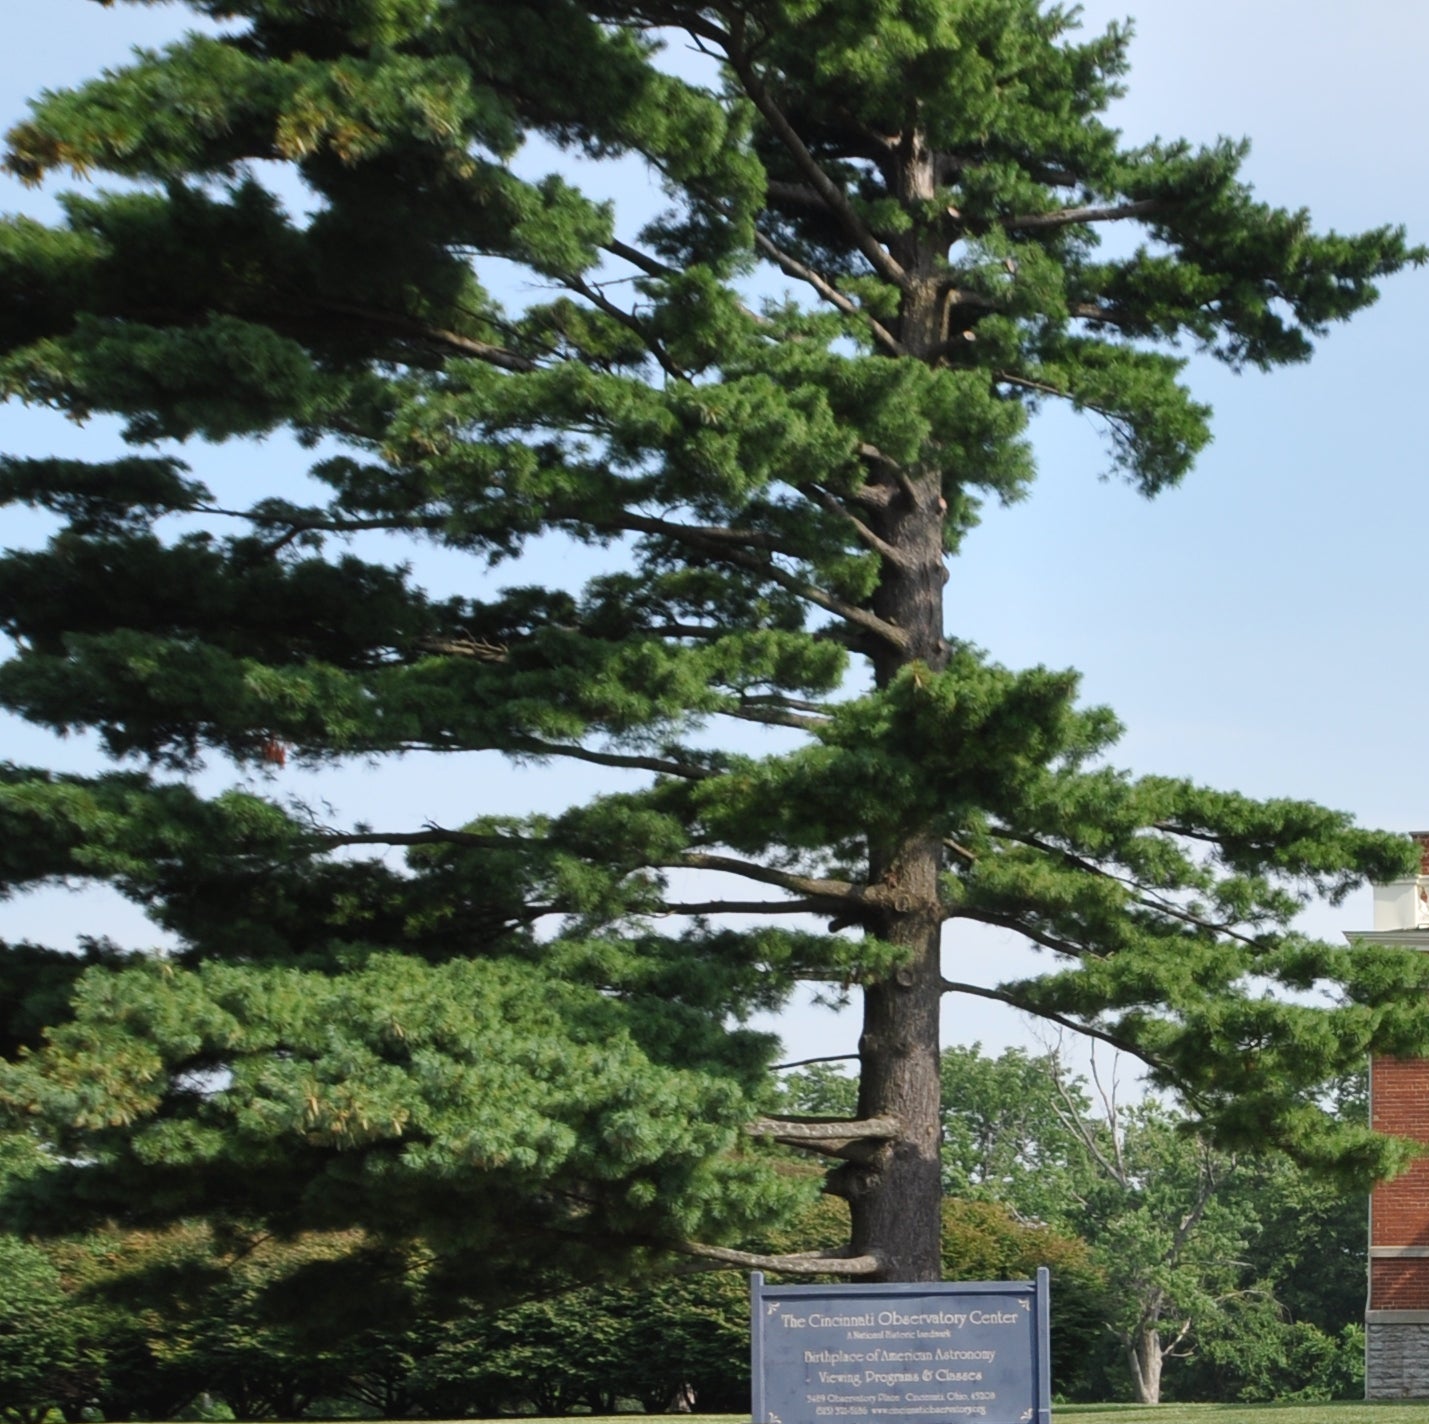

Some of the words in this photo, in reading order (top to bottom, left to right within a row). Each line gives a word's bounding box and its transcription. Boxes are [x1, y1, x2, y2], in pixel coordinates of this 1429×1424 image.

[781, 1314, 806, 1328] The
[808, 1313, 875, 1328] Cincinnati
[878, 1311, 967, 1328] Observatory
[969, 1310, 1018, 1325] Center
[804, 1350, 864, 1366] Birthplace
[866, 1349, 880, 1361] of
[881, 1350, 933, 1362] American
[935, 1348, 996, 1363] Astronomy
[865, 1370, 919, 1386] Programs
[935, 1368, 982, 1381] Classes
[827, 1394, 876, 1405] Observatory
[878, 1393, 899, 1402] Place
